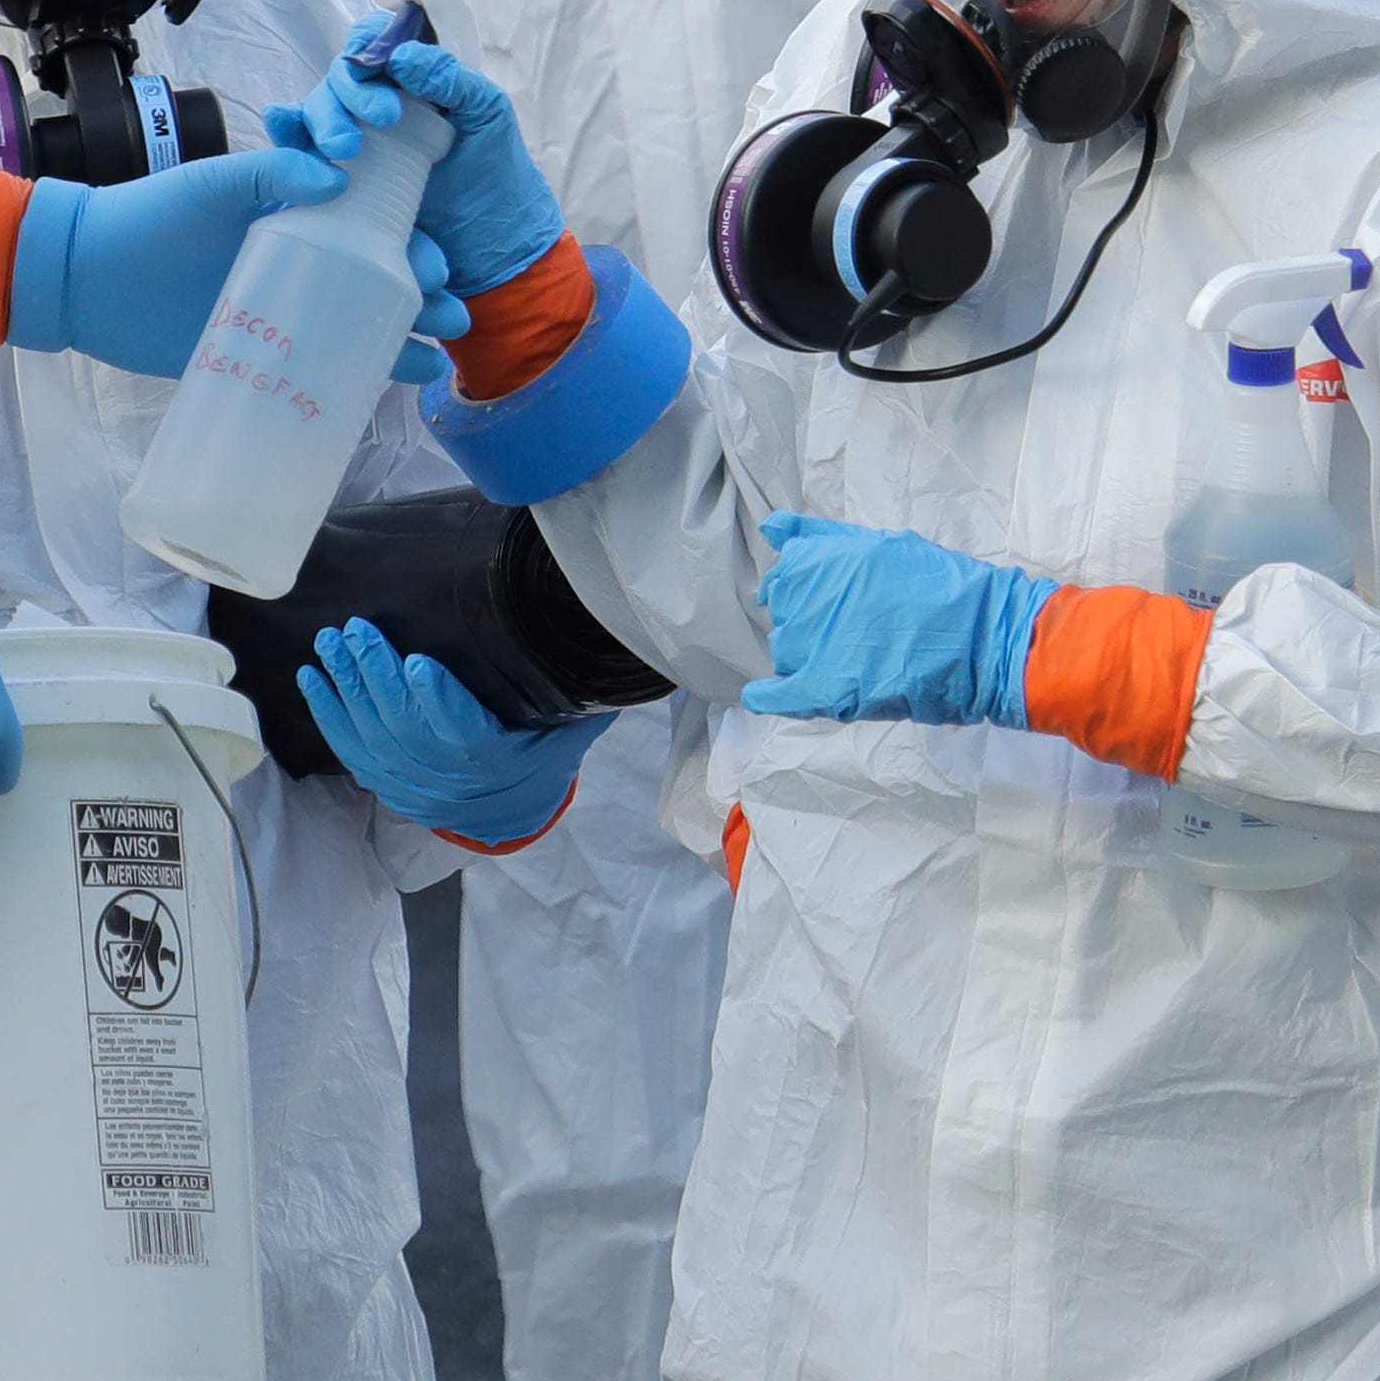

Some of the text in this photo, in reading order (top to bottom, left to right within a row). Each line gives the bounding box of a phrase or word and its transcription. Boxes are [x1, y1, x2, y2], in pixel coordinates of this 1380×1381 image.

[151, 108, 169, 136] 3M
[721, 189, 737, 236] NIOSH
[99, 806, 174, 830] WARNING
[113, 836, 159, 858] AVISO
[107, 864, 181, 887] AVERTISSEMENT
[111, 1175, 207, 1189] FOOD GRADE
